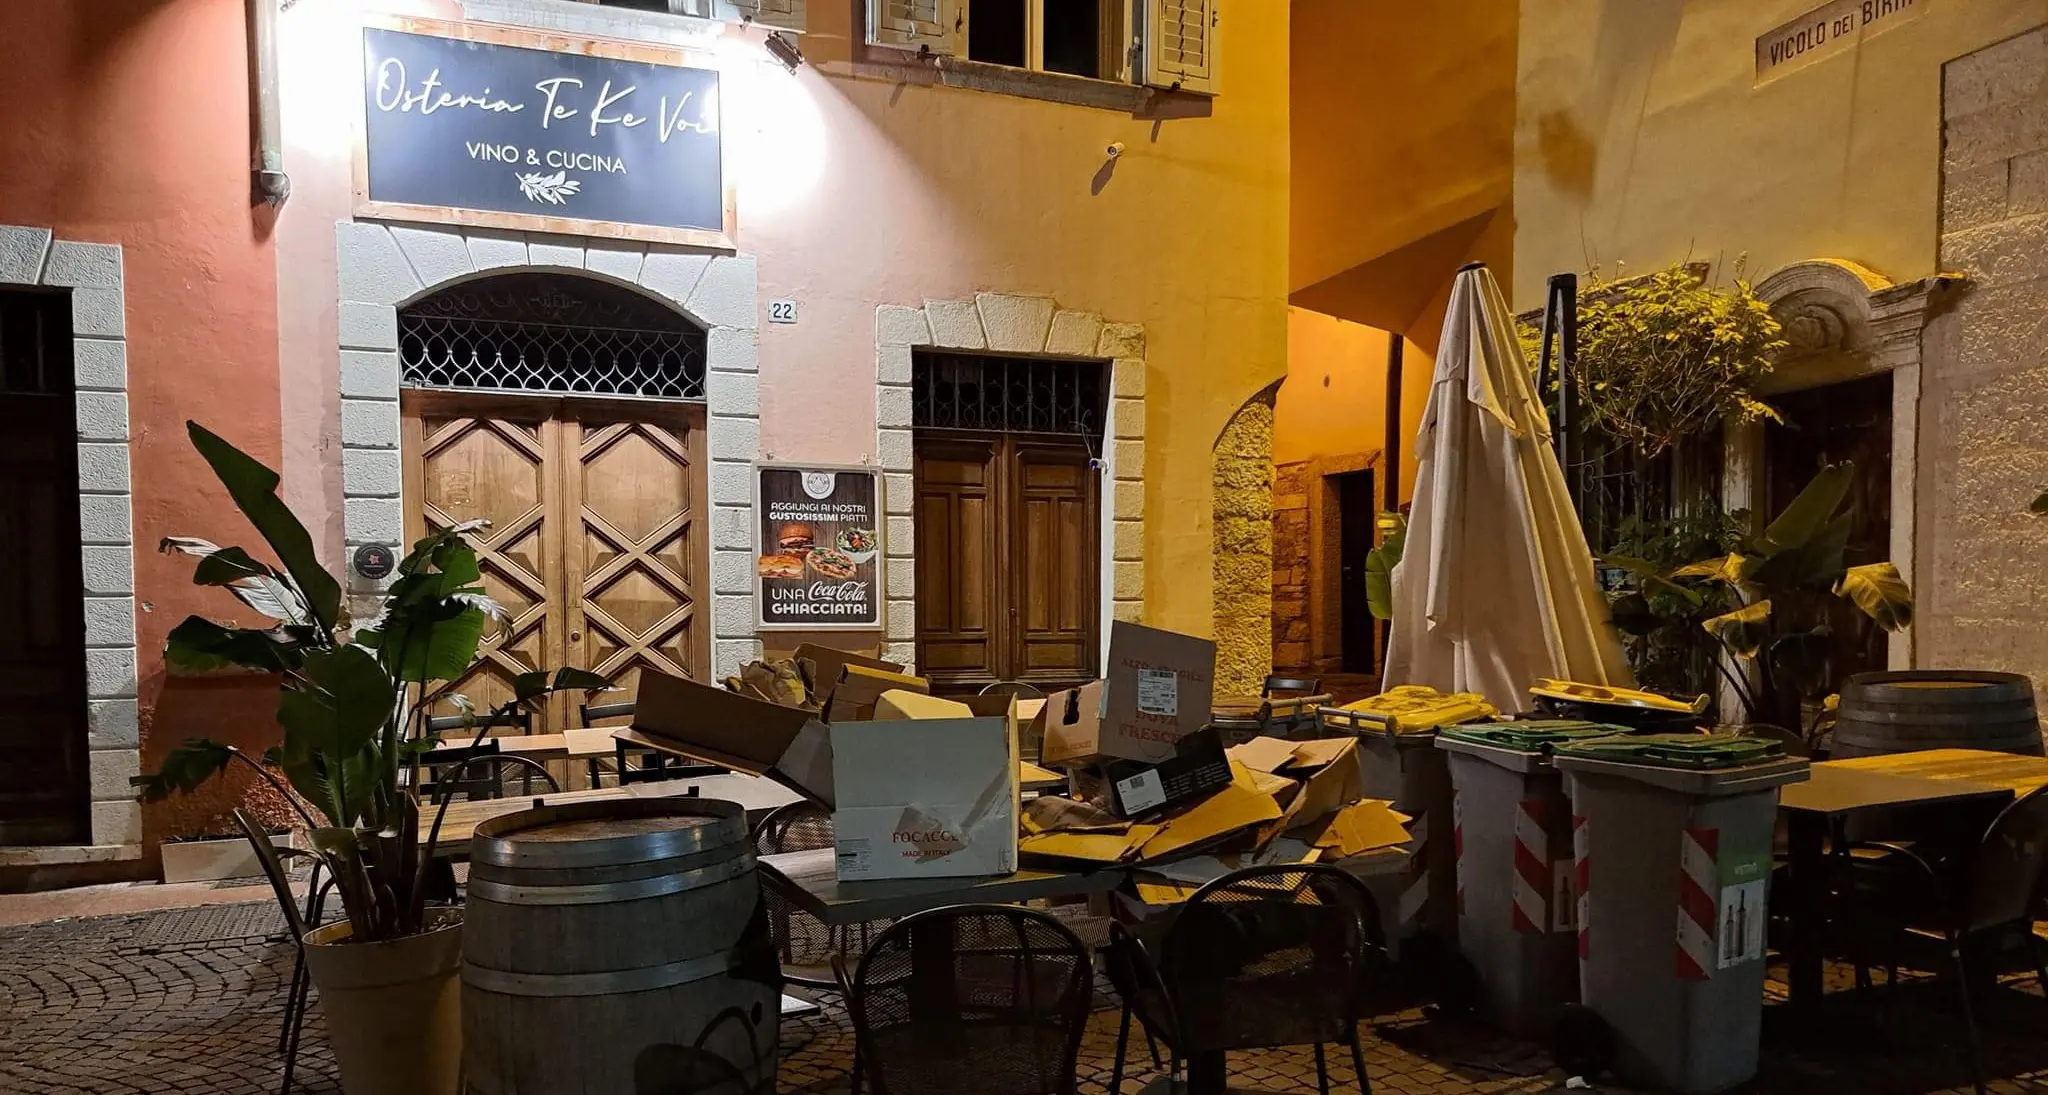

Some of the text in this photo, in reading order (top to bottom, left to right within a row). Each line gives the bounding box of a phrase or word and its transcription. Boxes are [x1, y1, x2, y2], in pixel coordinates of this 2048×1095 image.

[1770, 21, 1826, 66] VICOLO
[1833, 14, 1854, 39] DEI
[375, 57, 524, 116] Osteria
[535, 77, 584, 128] Te
[590, 80, 647, 137] Ke
[466, 141, 627, 174] VINO & CUCINA
[773, 303, 792, 319] 22
[769, 511, 868, 522] GUSTOSISSIMI PIATTI
[771, 502, 866, 513] AGGIUNGI AI NOSTRI
[772, 580, 869, 601] UNA Coca-Cola
[771, 603, 868, 615] GHIACCIATA!
